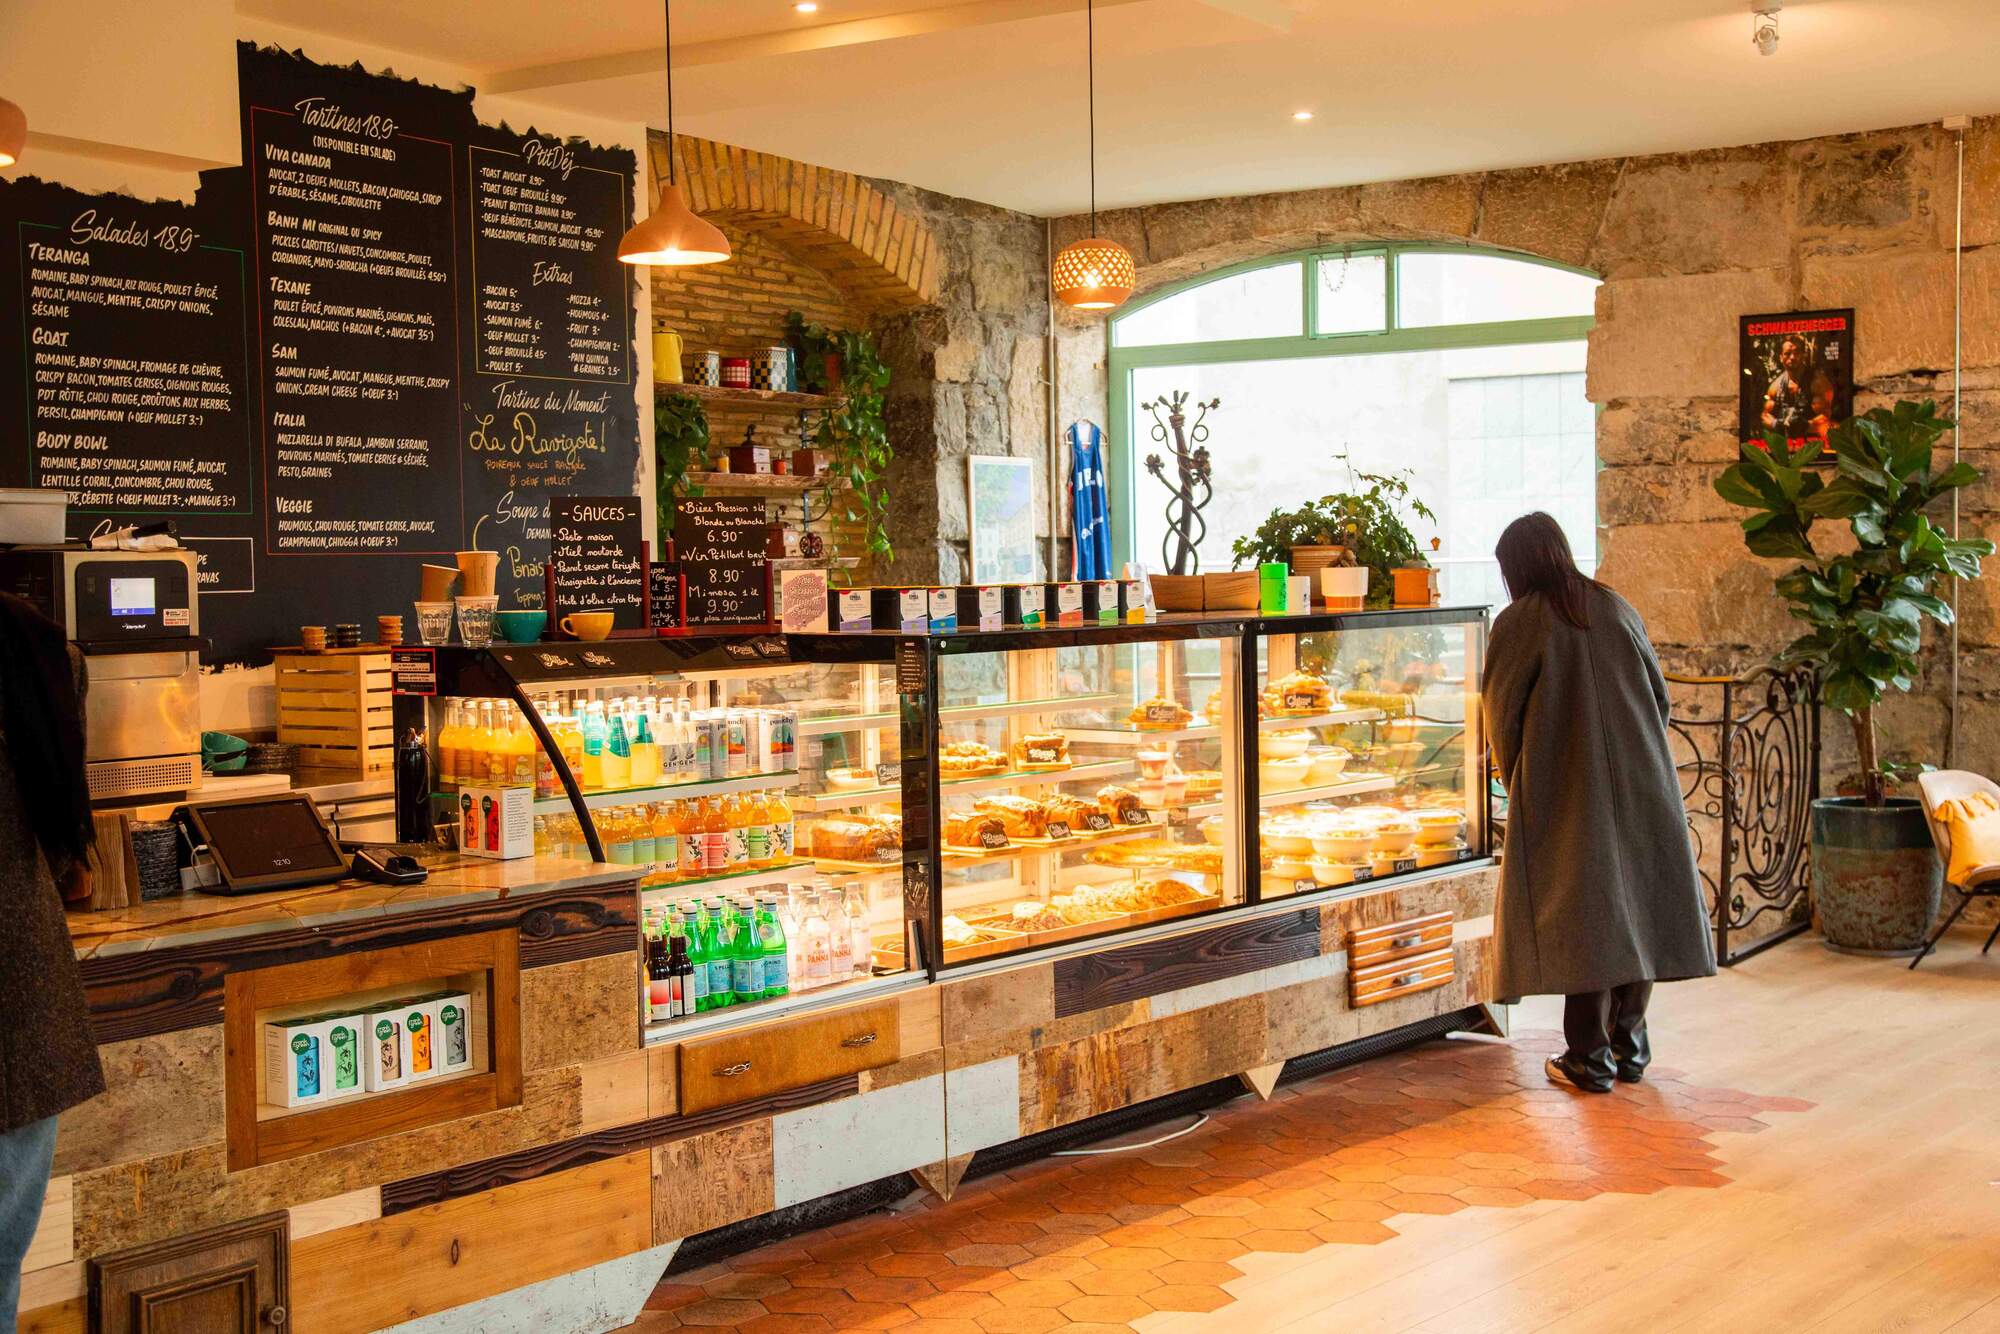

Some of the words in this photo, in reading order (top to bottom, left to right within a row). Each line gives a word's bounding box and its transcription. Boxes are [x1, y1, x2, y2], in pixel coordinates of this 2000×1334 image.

[295, 97, 360, 133] Tartines
[265, 143, 289, 163] VIVA
[292, 151, 331, 170] CANADA
[341, 195, 382, 210] CIBOULETTE
[510, 201, 533, 213] BUTTER
[536, 205, 559, 217] BANANA
[70, 209, 149, 247] Salades
[268, 211, 298, 229] BANH
[302, 218, 316, 231] MI
[318, 223, 349, 236] ORIGINAL
[351, 228, 359, 238] OU
[362, 229, 382, 241] SPICY
[272, 235, 299, 248] PICKLES
[29, 243, 90, 266] TERANGA
[533, 261, 572, 286] Extras
[70, 273, 89, 284] BABY
[125, 280, 137, 290] RIZ
[164, 284, 192, 296] POULET
[270, 276, 311, 295] TEXANE
[31, 301, 69, 318] SÉSAME
[146, 298, 176, 310] CRISPY
[274, 300, 299, 312] POULET
[324, 305, 354, 317] POIVRONS
[311, 319, 339, 332] NACHOS
[272, 343, 297, 360] SAM
[79, 356, 101, 368] BABY
[140, 361, 177, 374] FROMAGE
[179, 364, 189, 374] DE
[36, 370, 64, 383] CRISPY
[98, 375, 132, 387] TOMATES
[167, 379, 199, 391] OIGNONS
[275, 366, 305, 378] SAUMON
[427, 377, 450, 388] CRISPY
[38, 389, 56, 400] PDT
[87, 392, 109, 403] CHOU
[183, 397, 199, 408] AUX
[305, 384, 329, 395] CREAM
[332, 386, 357, 397] CHEESE
[492, 380, 541, 409] Tartine
[544, 391, 562, 411] du
[562, 389, 612, 414] Moment
[71, 408, 124, 421] CHAMPIGNON
[155, 413, 187, 424] MOLLET
[273, 412, 305, 427] ITALIA
[37, 431, 71, 449] BODY
[74, 434, 108, 450] BOWL
[277, 433, 323, 446] MOZZARELLA
[326, 436, 333, 446] DI
[366, 438, 394, 448] JAMBON
[81, 458, 102, 469] BABY
[140, 460, 171, 471] SAUMON
[302, 467, 332, 477] GRAINES
[42, 475, 80, 486] LENTILLE
[165, 478, 185, 488] CHOU
[145, 494, 172, 505] MOLLET
[276, 497, 312, 514] VEGGIE
[715, 501, 748, 513] Pression
[496, 490, 539, 533] Soupe
[315, 521, 333, 531] CHOU
[358, 521, 384, 531] TOMATE
[694, 516, 725, 526] Blonde
[735, 517, 764, 525] Blanche
[558, 528, 583, 542] Pesto
[558, 546, 582, 557] Miel
[587, 544, 624, 557] moutarde
[685, 546, 709, 561] Vin
[557, 561, 582, 574] Peanut
[557, 575, 598, 589] Vinaigrette
[688, 585, 737, 598] Mimosa
